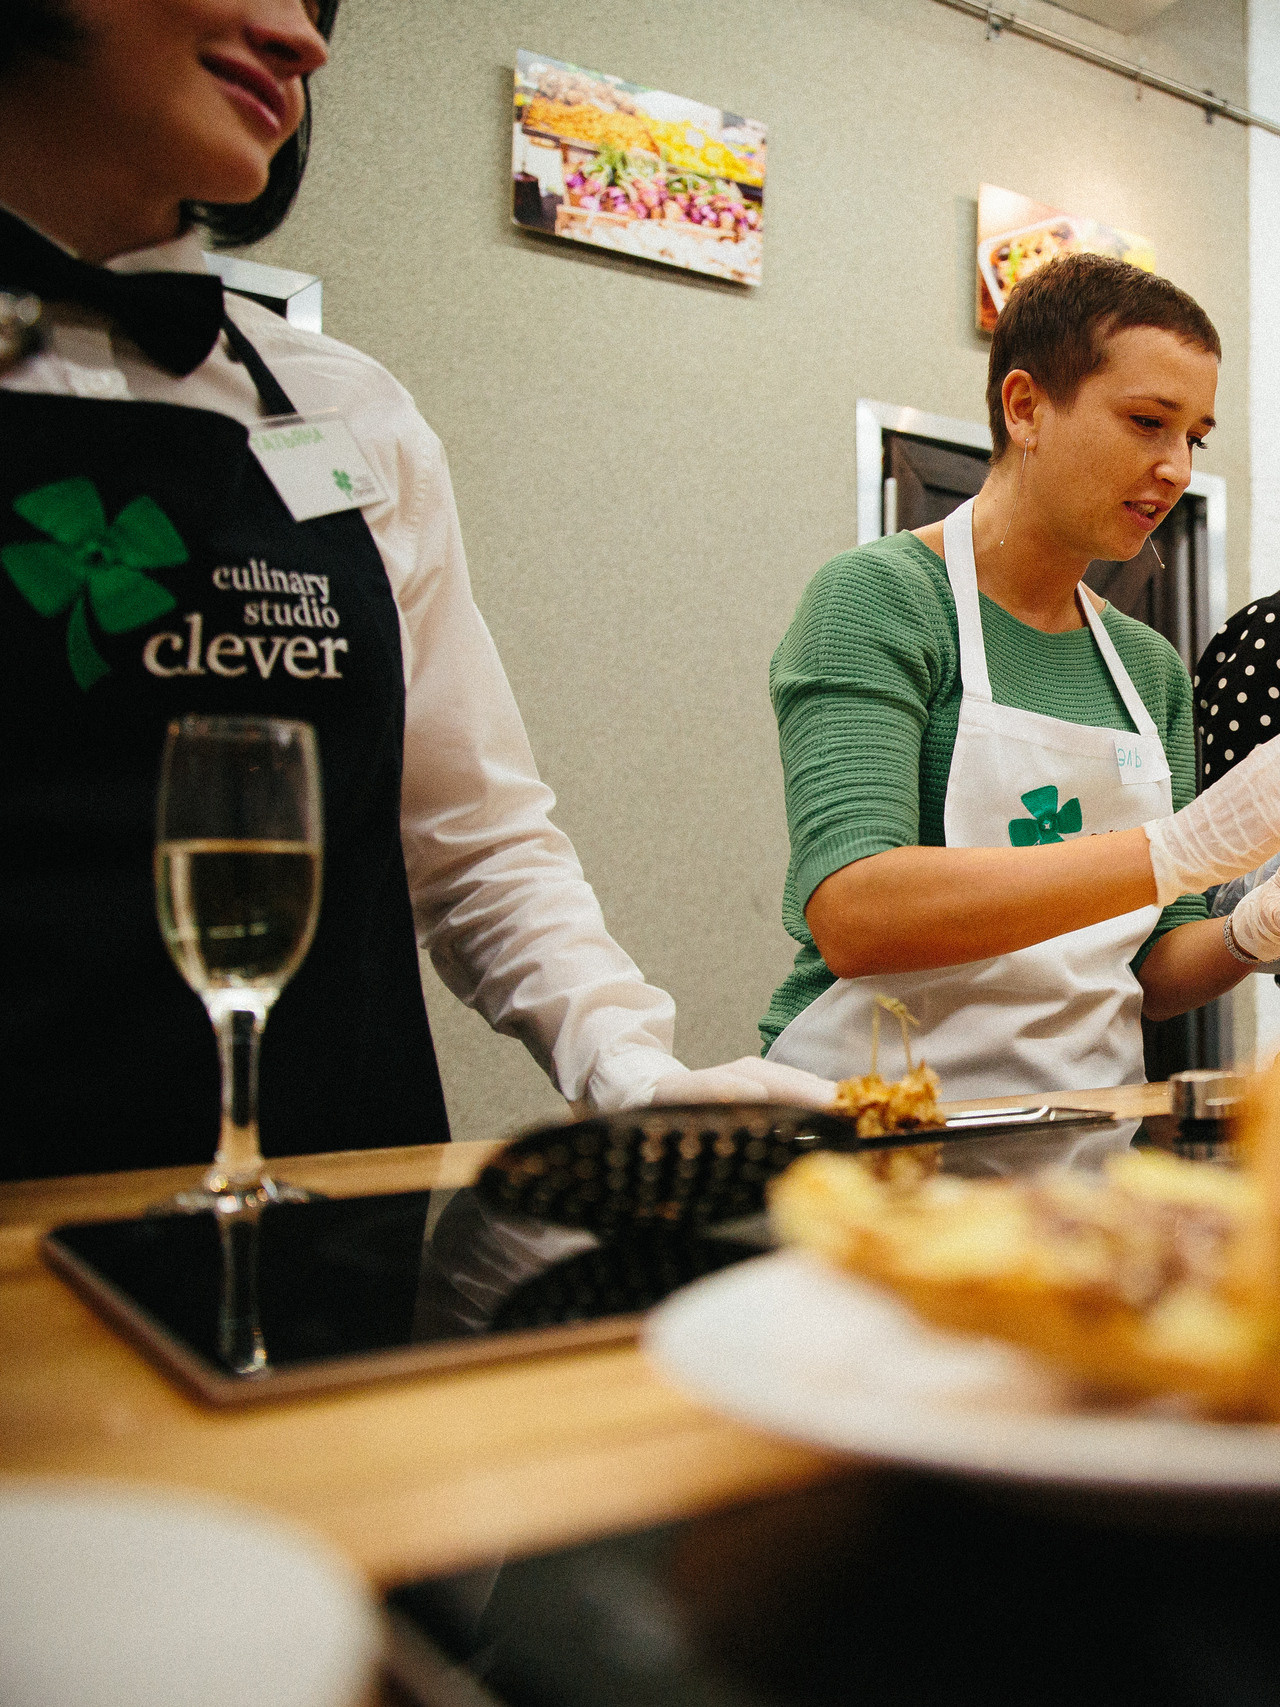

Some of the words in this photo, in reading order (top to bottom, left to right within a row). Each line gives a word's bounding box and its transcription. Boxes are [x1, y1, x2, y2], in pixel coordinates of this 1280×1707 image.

[211, 557, 330, 604] culinary
[243, 597, 341, 629] studio
[142, 611, 350, 680] clever
